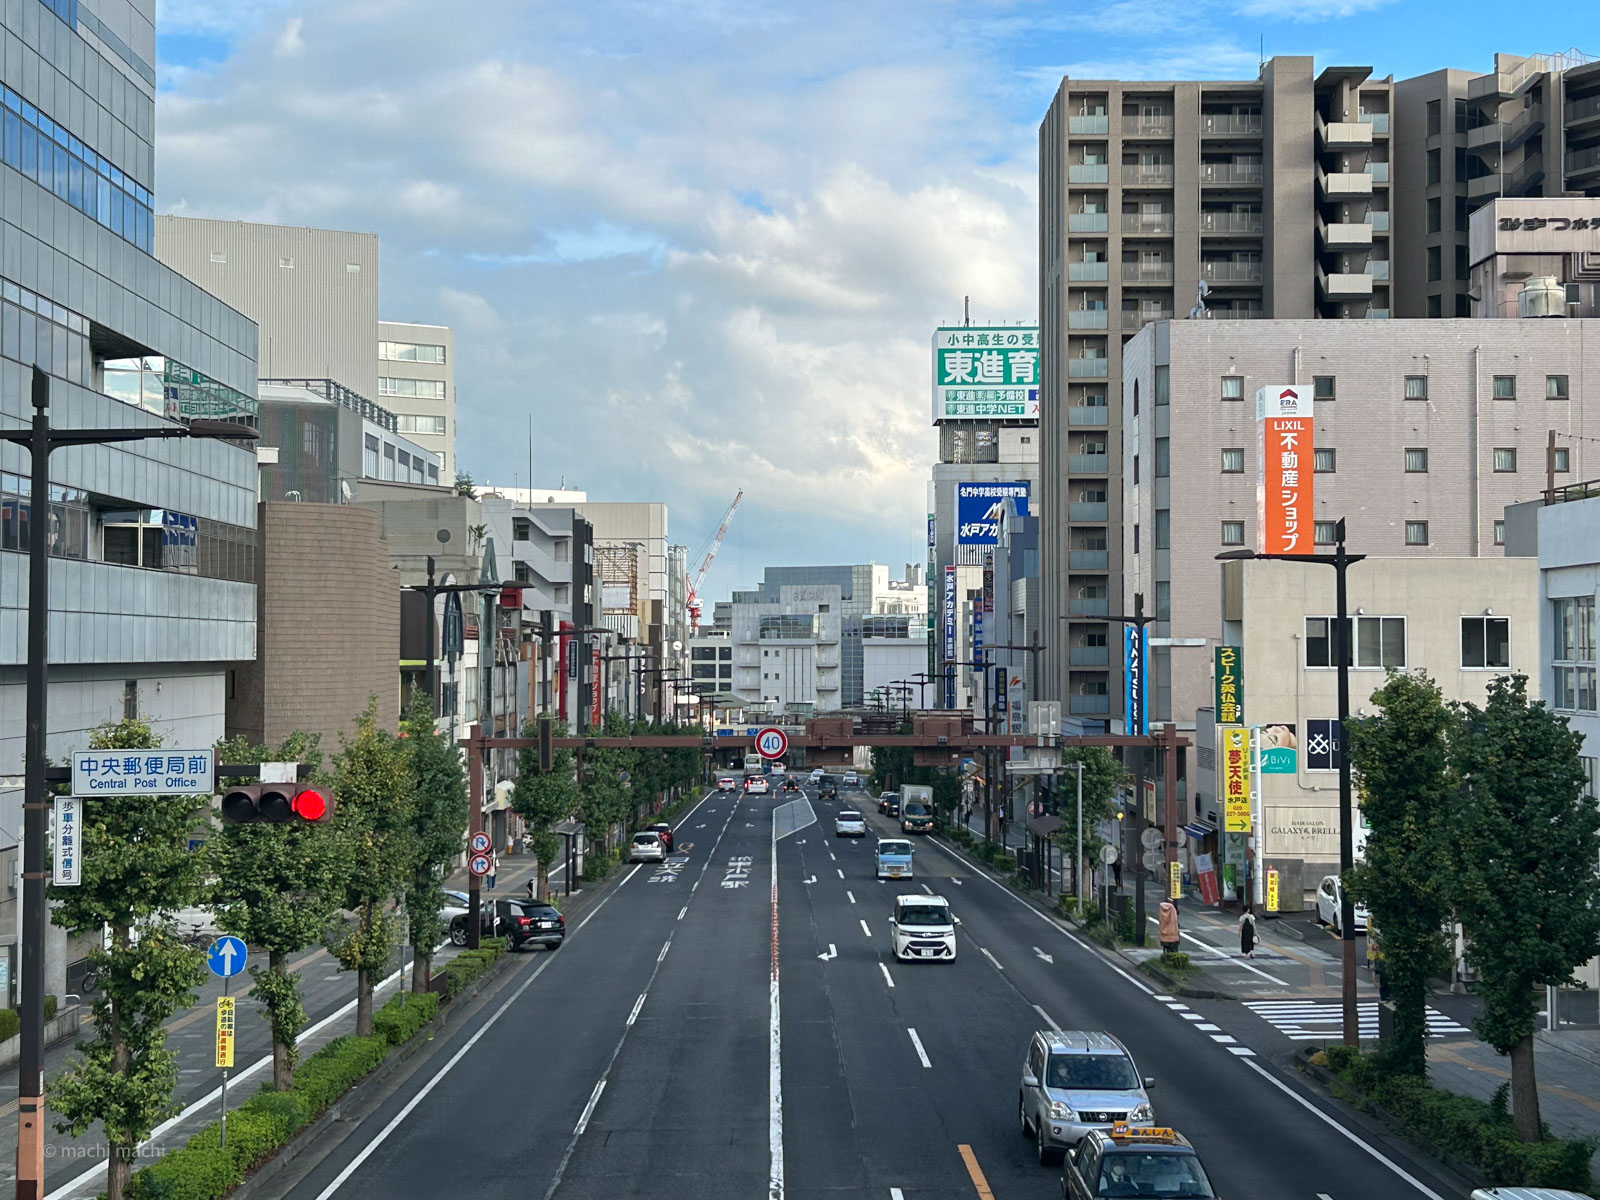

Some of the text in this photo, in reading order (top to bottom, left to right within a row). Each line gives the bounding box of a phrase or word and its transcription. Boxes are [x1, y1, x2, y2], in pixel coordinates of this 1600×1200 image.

[947, 333, 1039, 346] 小中高生の受
[944, 350, 1039, 383] 東進育
[1274, 421, 1304, 430] LIXIL
[1280, 433, 1299, 551] 不動産ショップ
[946, 574, 954, 634] 水戸アカデミー
[1221, 648, 1235, 722] スピーク英仏会話
[763, 737, 780, 750] 40
[80, 755, 207, 776] 中央郵便局前
[1228, 750, 1243, 795] 夢天使
[89, 777, 197, 789] Central Post Office
[61, 801, 74, 881] 歩車分離式信号
